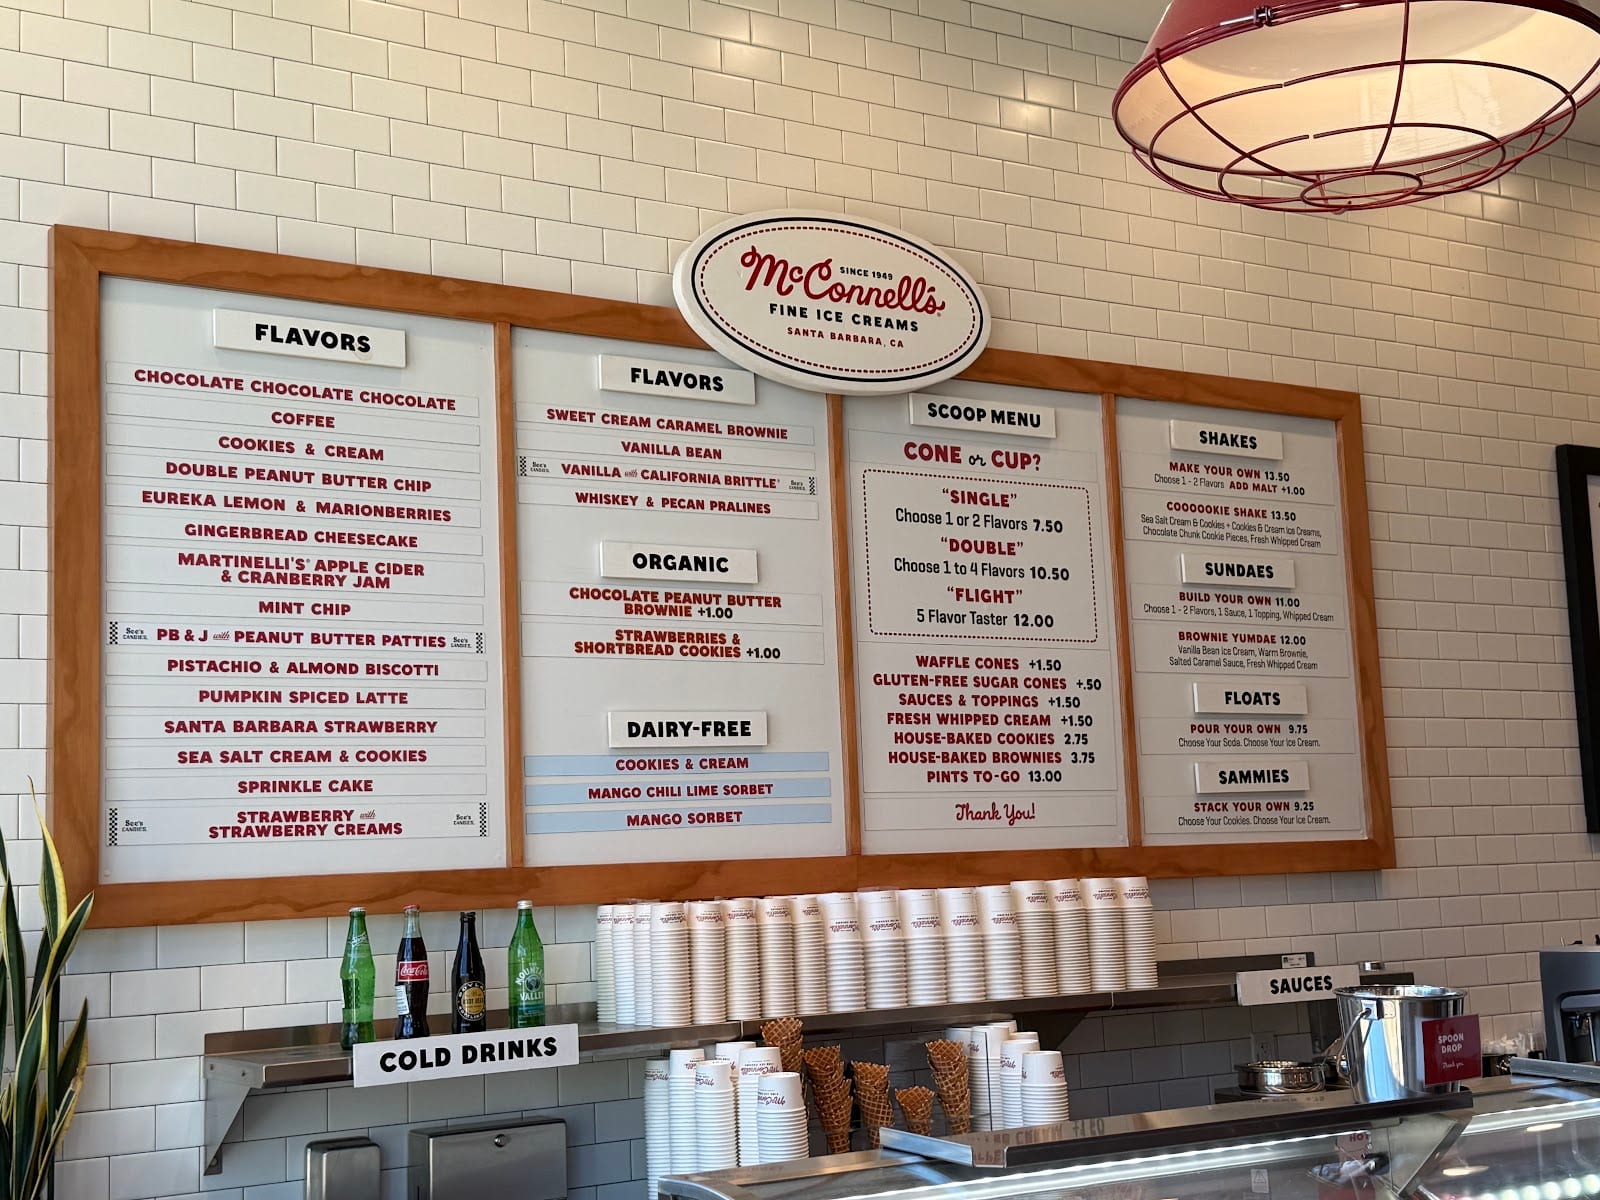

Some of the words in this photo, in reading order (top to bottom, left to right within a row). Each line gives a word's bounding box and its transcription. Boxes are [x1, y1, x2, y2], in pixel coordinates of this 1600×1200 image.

[740, 246, 946, 314] McConnell's
[839, 266, 868, 277] SINCE
[871, 271, 893, 280] 1949
[769, 303, 808, 318] FINE
[816, 308, 843, 323] ICE
[851, 313, 918, 332] CREAMS
[255, 323, 370, 353] FLAVORS
[787, 326, 824, 338] SANTA
[890, 339, 904, 348] CA
[630, 367, 723, 392] FLAVORS
[134, 369, 244, 391] CHOCOLATE
[250, 380, 353, 401] CHOCOLATE
[359, 390, 456, 411] CHOCOLATE
[271, 411, 335, 428] COFFEE
[546, 408, 596, 423] SWEET
[601, 413, 651, 428] CREAM
[656, 418, 722, 434] CARAMEL
[727, 424, 788, 440] BROWNIE
[927, 402, 986, 422] SCOOP
[990, 409, 1040, 428] MENU
[218, 436, 295, 454] COOKIES
[305, 443, 315, 455] &
[324, 445, 383, 461] CREAM
[1199, 430, 1257, 449] SHAKES
[903, 441, 962, 464] CONE
[968, 454, 986, 466] or
[991, 450, 1040, 471] CUP?
[166, 461, 238, 478] DOUBLE
[244, 467, 315, 484] PEANUT
[321, 473, 387, 489] BUTTER
[393, 478, 431, 492] CHIP
[561, 463, 621, 478] VANILLA
[640, 469, 721, 485] CALIFORNIA
[1169, 461, 1200, 473] MAKE
[1203, 464, 1232, 477] YOUR
[1236, 468, 1260, 479] OWN
[1264, 470, 1290, 482] 13.50
[1154, 473, 1180, 485] Choose
[1181, 476, 1186, 485] 1
[1193, 477, 1198, 486] 2
[1199, 477, 1224, 488] Flavors
[1229, 480, 1248, 490] ADD
[1252, 482, 1278, 493] MALT
[1281, 485, 1305, 496] +1.00
[142, 490, 216, 507] EUREKA
[223, 495, 285, 511] LEMON
[296, 500, 306, 512] &
[316, 501, 451, 522] MARIONBERRIES
[575, 492, 638, 506] WHISKEY
[646, 496, 654, 507] &
[661, 497, 704, 510] PECAN
[709, 500, 771, 514] PRALINES
[1166, 501, 1230, 516] COOOOOKIE
[1233, 507, 1267, 519] SHAKE
[1270, 510, 1296, 521] 13.50
[895, 507, 942, 524] Choose
[945, 511, 953, 525] 1
[956, 515, 969, 526] or
[972, 513, 980, 527] 2
[983, 514, 1027, 531] Flavors
[1032, 518, 1063, 533] 7.50
[314, 559, 368, 574] APPLE
[374, 562, 424, 576] CIDER
[632, 552, 729, 573] ORGANIC
[894, 557, 940, 573] Choose
[943, 560, 951, 574] 1
[953, 562, 967, 575] to
[970, 562, 978, 576] 4
[981, 562, 1025, 578] Flavors
[1029, 566, 1069, 581] 10.50
[1205, 562, 1274, 579] SUNDAES
[221, 569, 232, 582] &
[237, 570, 347, 587] CRANBERRY
[352, 575, 390, 589] JAM
[569, 587, 659, 603] CHOCOLATE
[664, 591, 722, 605] PEANUT
[727, 594, 782, 608] BUTTER
[1179, 591, 1210, 602] BUILD
[1214, 593, 1243, 604] YOUR
[1247, 595, 1271, 606] OWN
[1275, 597, 1300, 607] 11.00
[624, 602, 692, 617] BROWNIE
[697, 606, 733, 619] +1.00
[916, 608, 925, 622] 5
[928, 609, 967, 624] Flavor
[969, 610, 1008, 626] Taster
[1013, 613, 1054, 628] 12.00
[157, 628, 180, 641] PB
[184, 629, 194, 642] &
[198, 629, 208, 642] J
[234, 630, 304, 644] PEANUT
[310, 632, 375, 646] BUTTER
[382, 634, 446, 648] PATTIES
[1178, 631, 1228, 642] BROWNIE
[1231, 633, 1276, 644] YUMDAE
[1280, 635, 1306, 645] 12.00
[873, 673, 968, 687] GLUTEN-FREE
[973, 675, 1018, 688] SUGAR
[1023, 677, 1066, 689] CONES
[1076, 678, 1102, 690] +.50
[1224, 691, 1280, 706] FLOATS
[627, 720, 751, 738] DAIRY-FREE
[177, 750, 213, 764] SEA
[219, 750, 263, 763] SALT
[269, 750, 331, 763] CREAM
[339, 750, 349, 762] &
[355, 750, 427, 762] COOKIES
[927, 770, 968, 783] PINTS
[973, 770, 1020, 783] TO-GO
[1028, 770, 1062, 782] 13.00
[1218, 769, 1289, 785] SAMMIES
[588, 787, 641, 799] MANGO
[646, 786, 681, 798] CHILI
[686, 785, 718, 796] LIME
[722, 783, 773, 796] SORBET
[954, 801, 1002, 821] Thank
[1003, 802, 1035, 826] You!
[1194, 802, 1228, 812] STACK
[1232, 802, 1261, 812] YOUR
[1265, 801, 1290, 811] OWN
[1294, 801, 1314, 811] 9.25
[1270, 975, 1333, 994] SAUCES
[1438, 1032, 1464, 1044] SPOON
[379, 1047, 451, 1072] COLD
[461, 1036, 557, 1064] DRINKS
[1442, 1044, 1462, 1054] DROP
